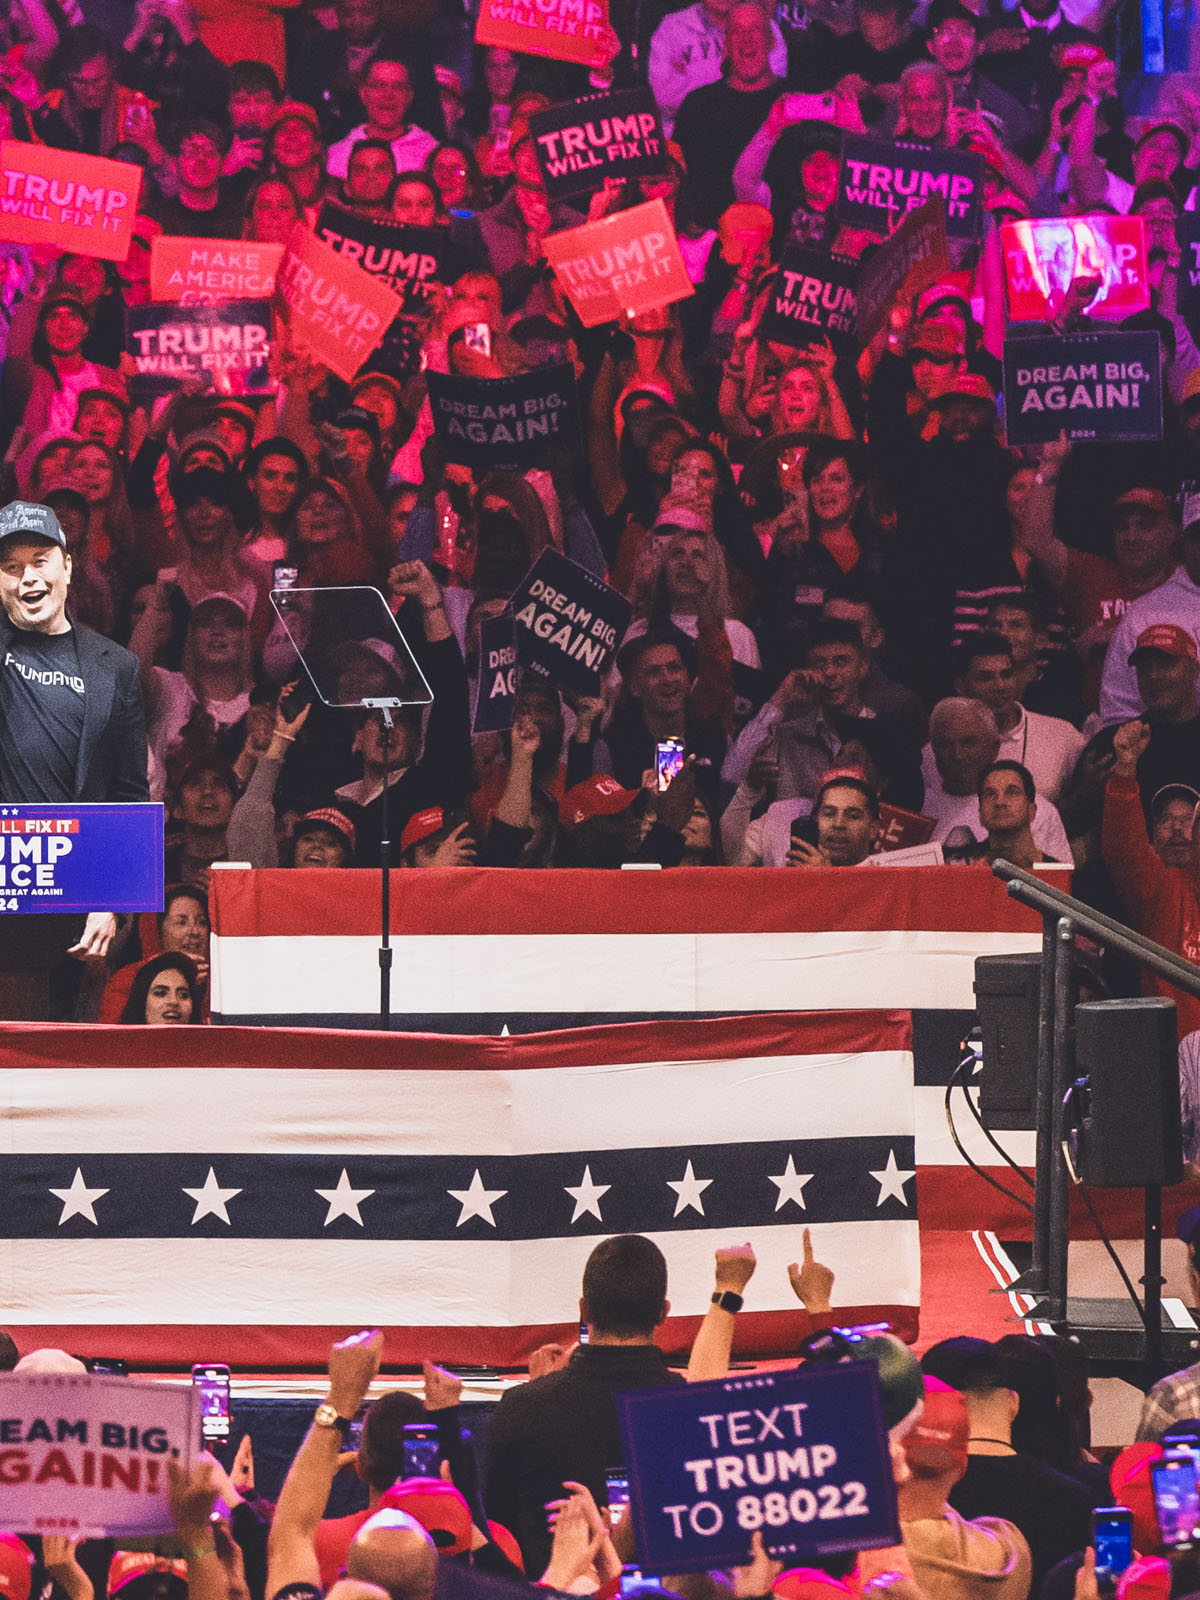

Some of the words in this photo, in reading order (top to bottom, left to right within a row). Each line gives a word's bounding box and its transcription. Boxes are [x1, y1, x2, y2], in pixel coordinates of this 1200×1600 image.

[490, 4, 538, 28] WILL
[545, 15, 578, 36] FIX
[583, 23, 605, 40] IT
[537, 112, 656, 161] TRUMP
[546, 150, 604, 178] WILL
[606, 141, 642, 162] FIX
[644, 139, 660, 157] IT
[3, 170, 128, 213] TRUMP
[846, 159, 974, 200] TRUMP
[1, 196, 53, 221] WILL
[60, 207, 95, 228] FIX
[102, 215, 122, 233] IT
[845, 185, 900, 211] WILL
[948, 200, 970, 218] IT
[191, 250, 261, 271] MAKE
[321, 227, 437, 281] TRUMP
[557, 232, 666, 284] TRUMP
[169, 269, 275, 291] AMERICA
[285, 252, 380, 333] TRUMP
[570, 281, 611, 299] WILL
[611, 266, 648, 291] FIX
[651, 256, 672, 277] IT
[783, 270, 858, 317] TRUM
[776, 297, 822, 325] WILL
[133, 325, 268, 355] TRUMP
[135, 355, 196, 373] WILL
[202, 352, 238, 369] FIX
[245, 350, 268, 367] IT
[1017, 363, 1098, 387] DREAM
[1104, 361, 1150, 384] BIG,
[440, 398, 516, 419] DREAM
[1021, 383, 1140, 415] AGAIN!
[448, 412, 558, 444] AGAIN!
[528, 579, 592, 629] DREAM
[515, 602, 606, 672] AGAIN!
[25, 820, 52, 833] FIX
[56, 820, 73, 833] IT
[31, 888, 63, 896] AGAIN!
[101, 1422, 180, 1457] BIG,
[699, 1403, 808, 1448] TEXT
[684, 1444, 837, 1493] TRUMP
[663, 1501, 724, 1539] TO
[737, 1481, 870, 1530] 88022
